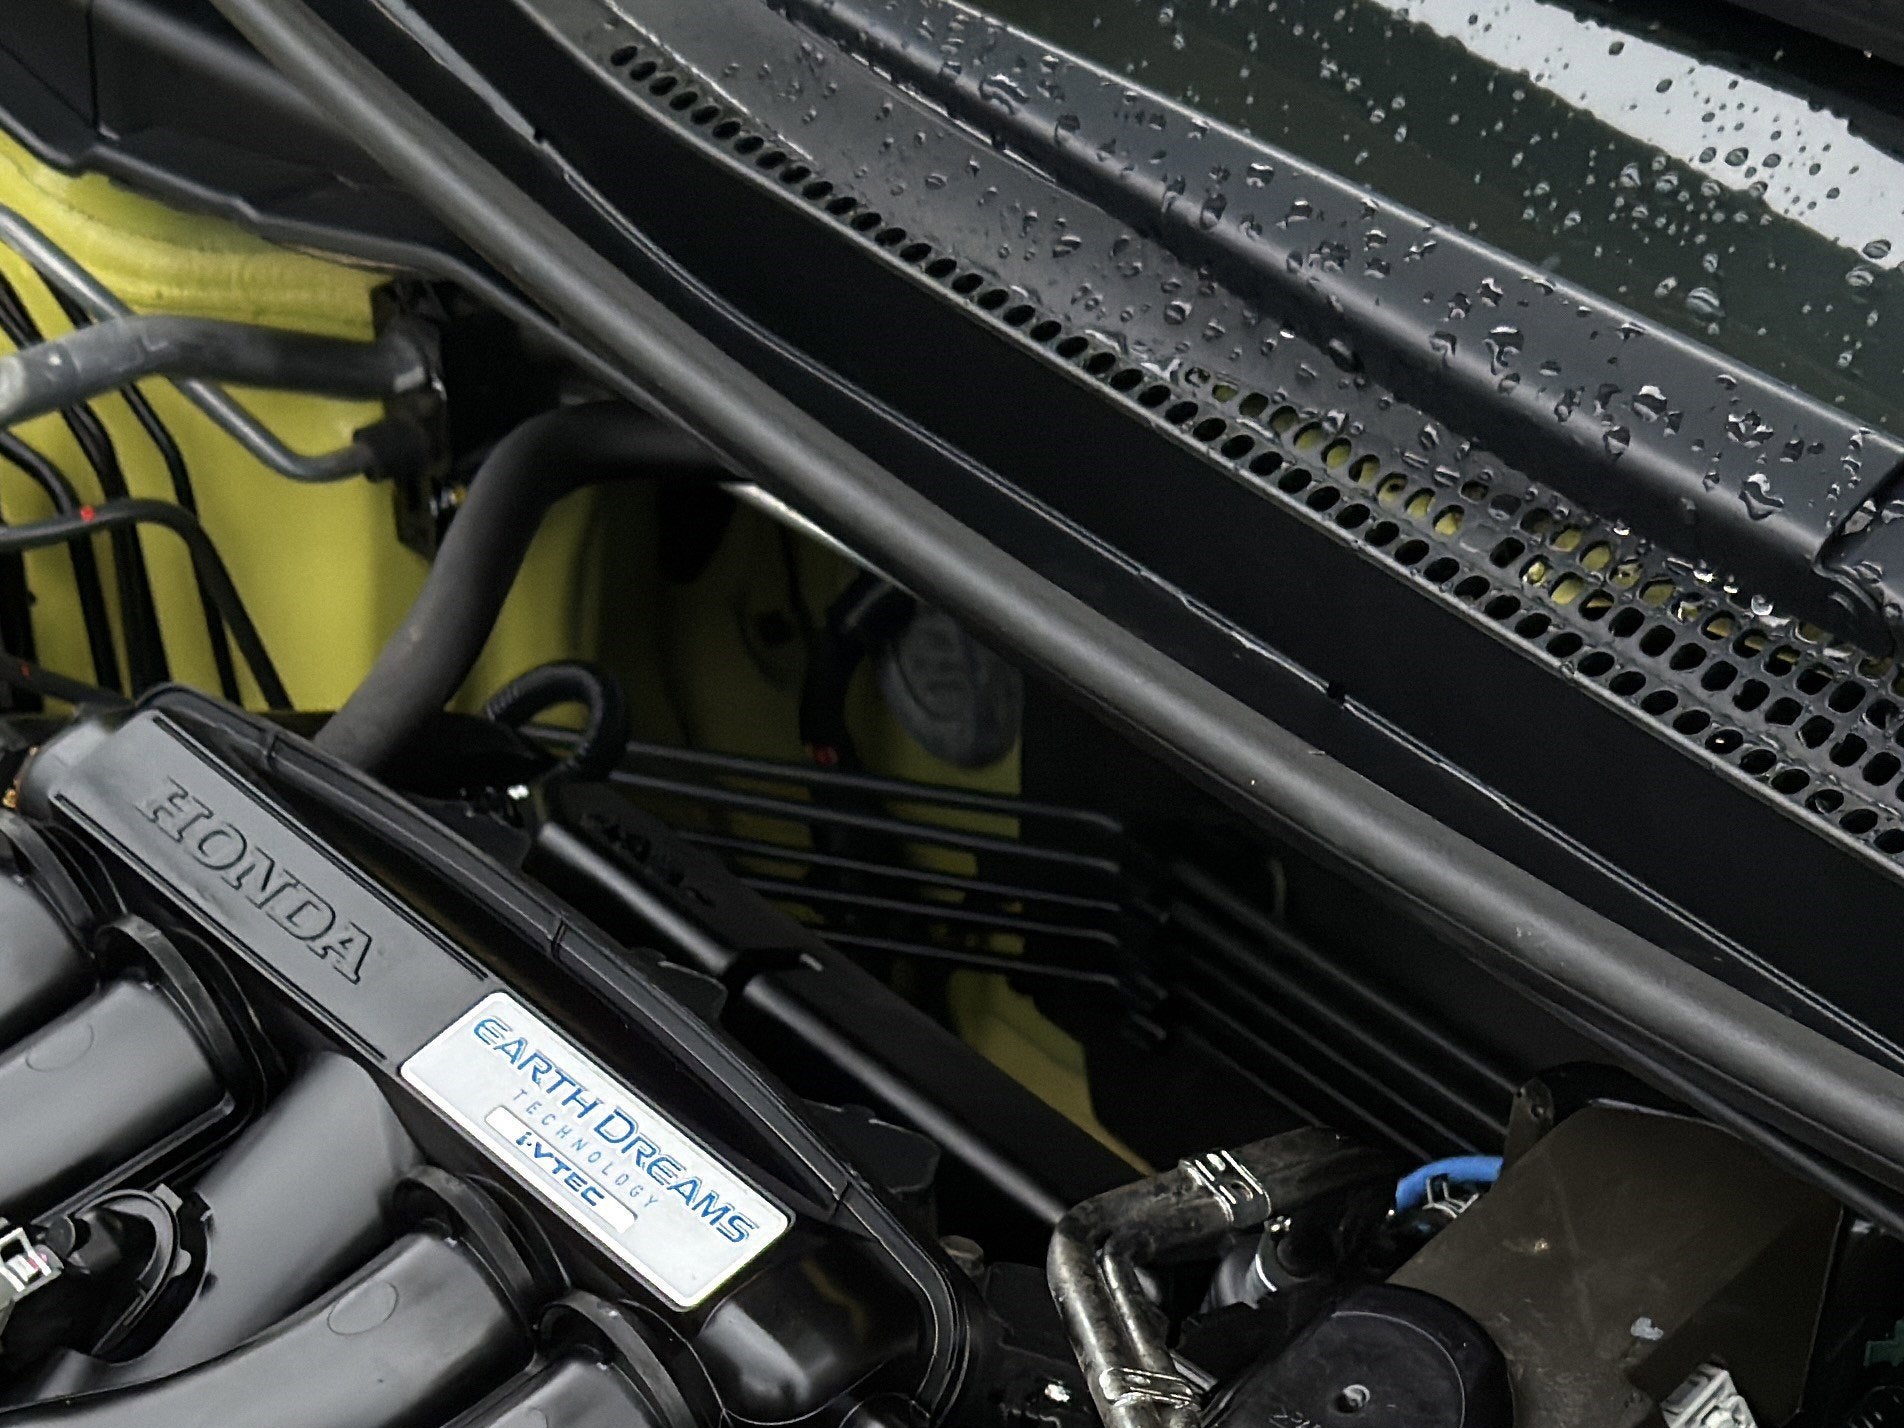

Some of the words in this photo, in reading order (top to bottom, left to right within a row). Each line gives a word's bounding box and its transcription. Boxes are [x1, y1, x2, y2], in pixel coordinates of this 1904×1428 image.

[133, 778, 379, 987] HONDA
[473, 1016, 604, 1118] EARTH
[594, 1106, 759, 1243] DREAMS
[512, 1088, 658, 1208] TECHNOLOGY
